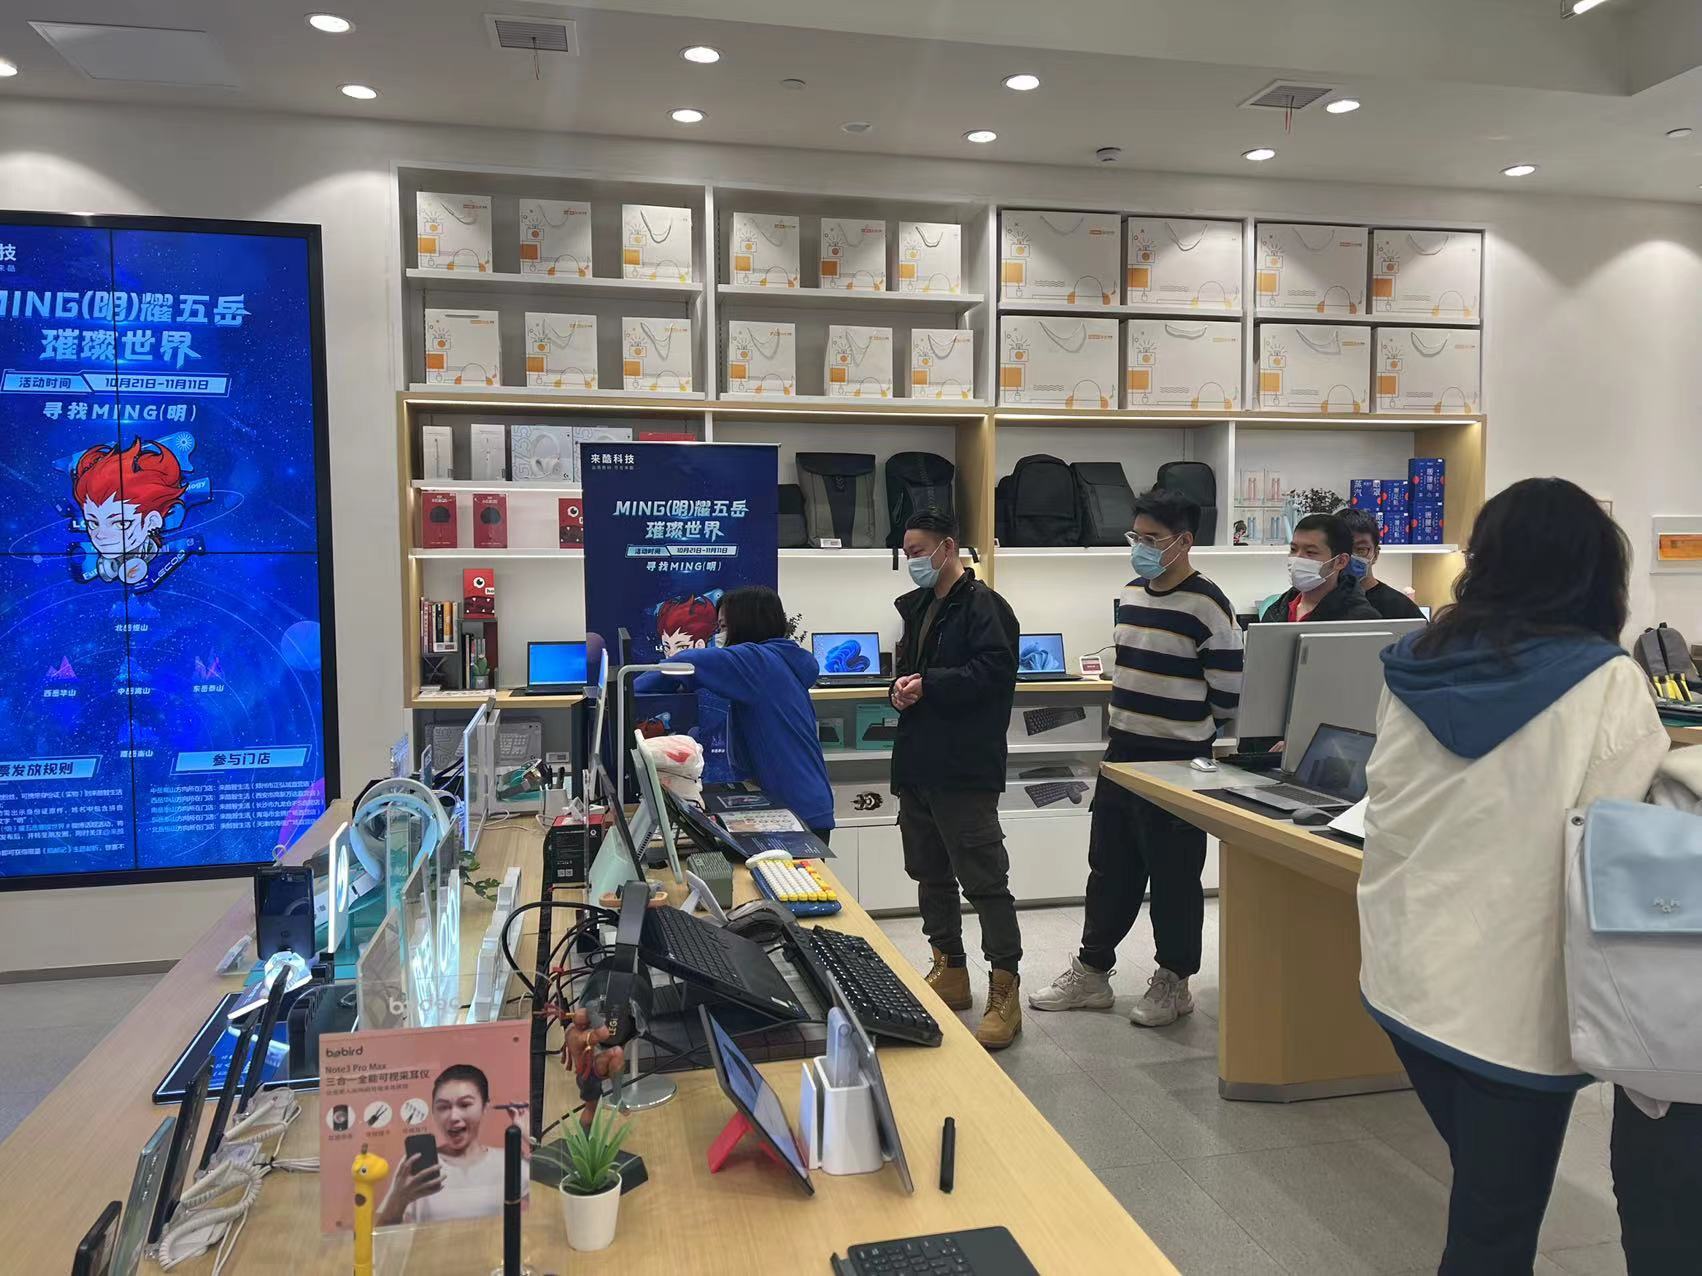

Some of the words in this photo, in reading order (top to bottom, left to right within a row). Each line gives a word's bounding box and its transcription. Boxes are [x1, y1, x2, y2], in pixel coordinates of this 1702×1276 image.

[40, 328, 202, 369] 璀璨世界
[18, 377, 72, 389] 活动时间
[590, 453, 635, 464] 来酷科技
[644, 520, 725, 542] 璀璨世界
[212, 752, 271, 767] 参与门店
